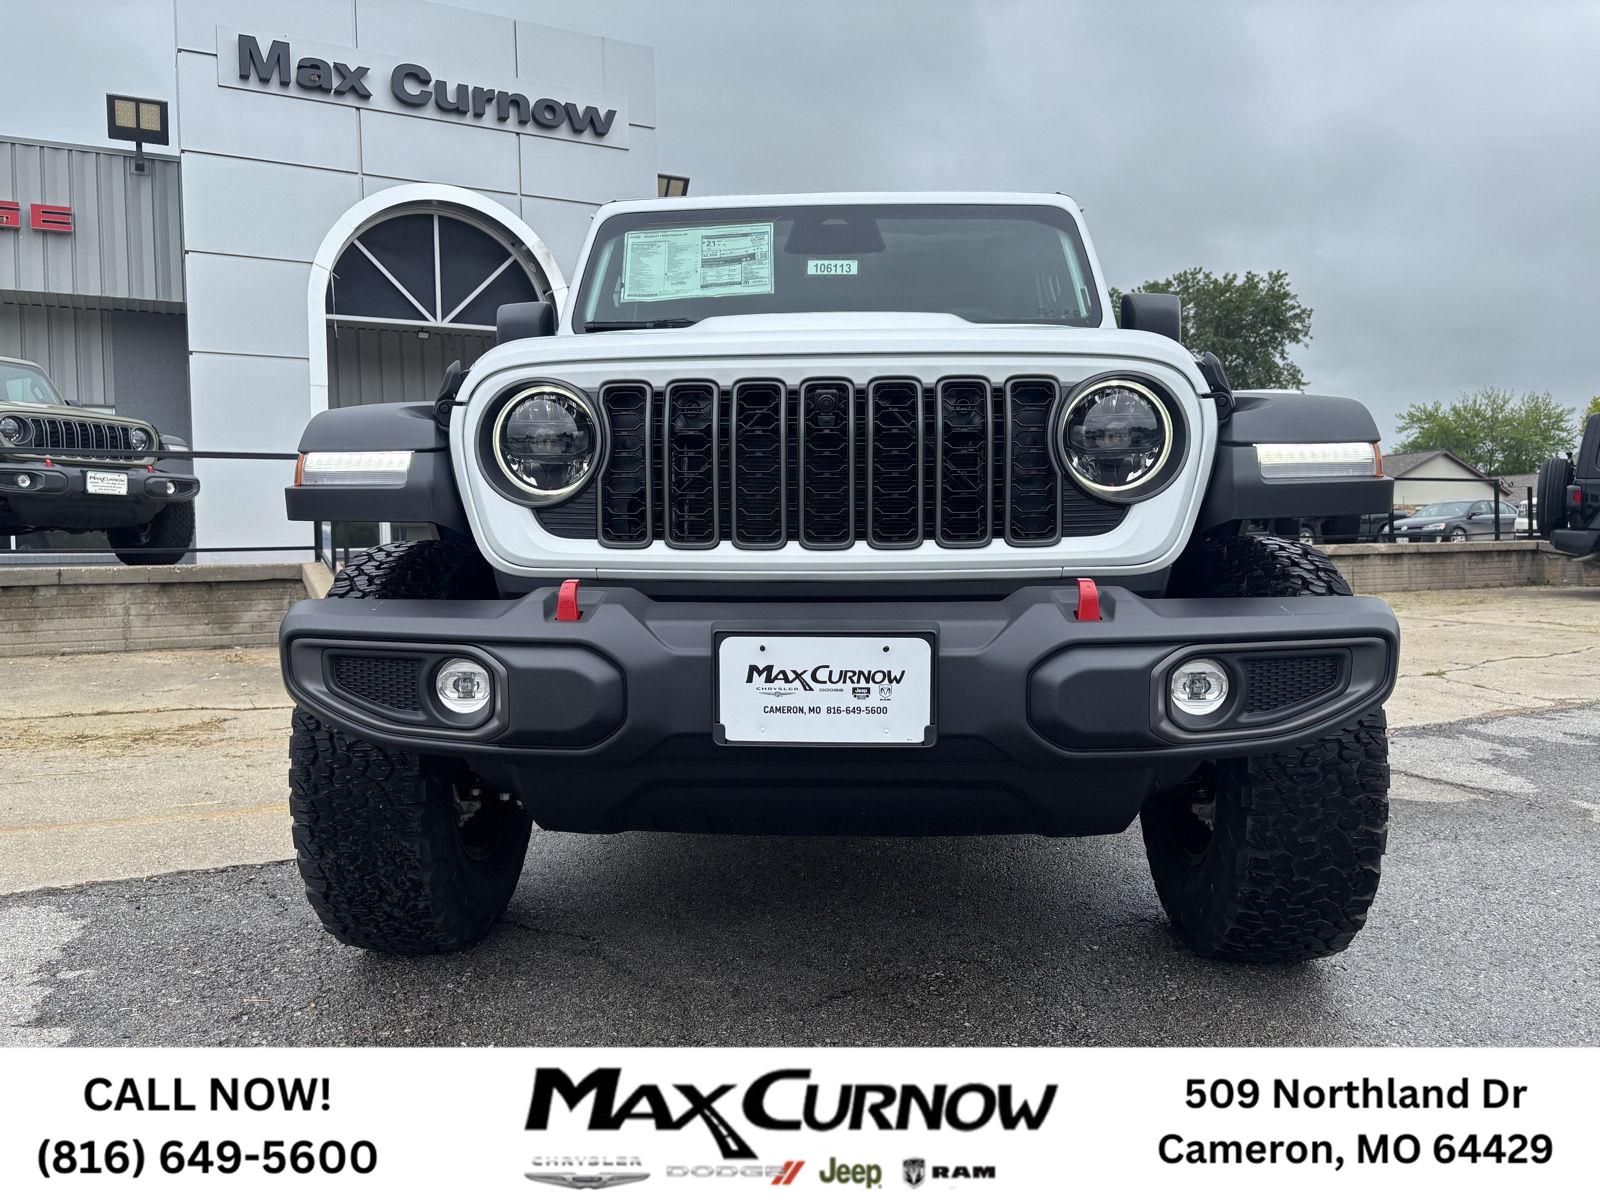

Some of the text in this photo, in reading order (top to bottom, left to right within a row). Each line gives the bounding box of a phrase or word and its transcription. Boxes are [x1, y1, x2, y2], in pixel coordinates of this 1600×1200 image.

[237, 33, 617, 136] Max Curnow
[813, 262, 851, 274] 106113
[746, 664, 906, 691] MAX CURNOW
[763, 705, 888, 715] CAMERON, MO 816-649-5600
